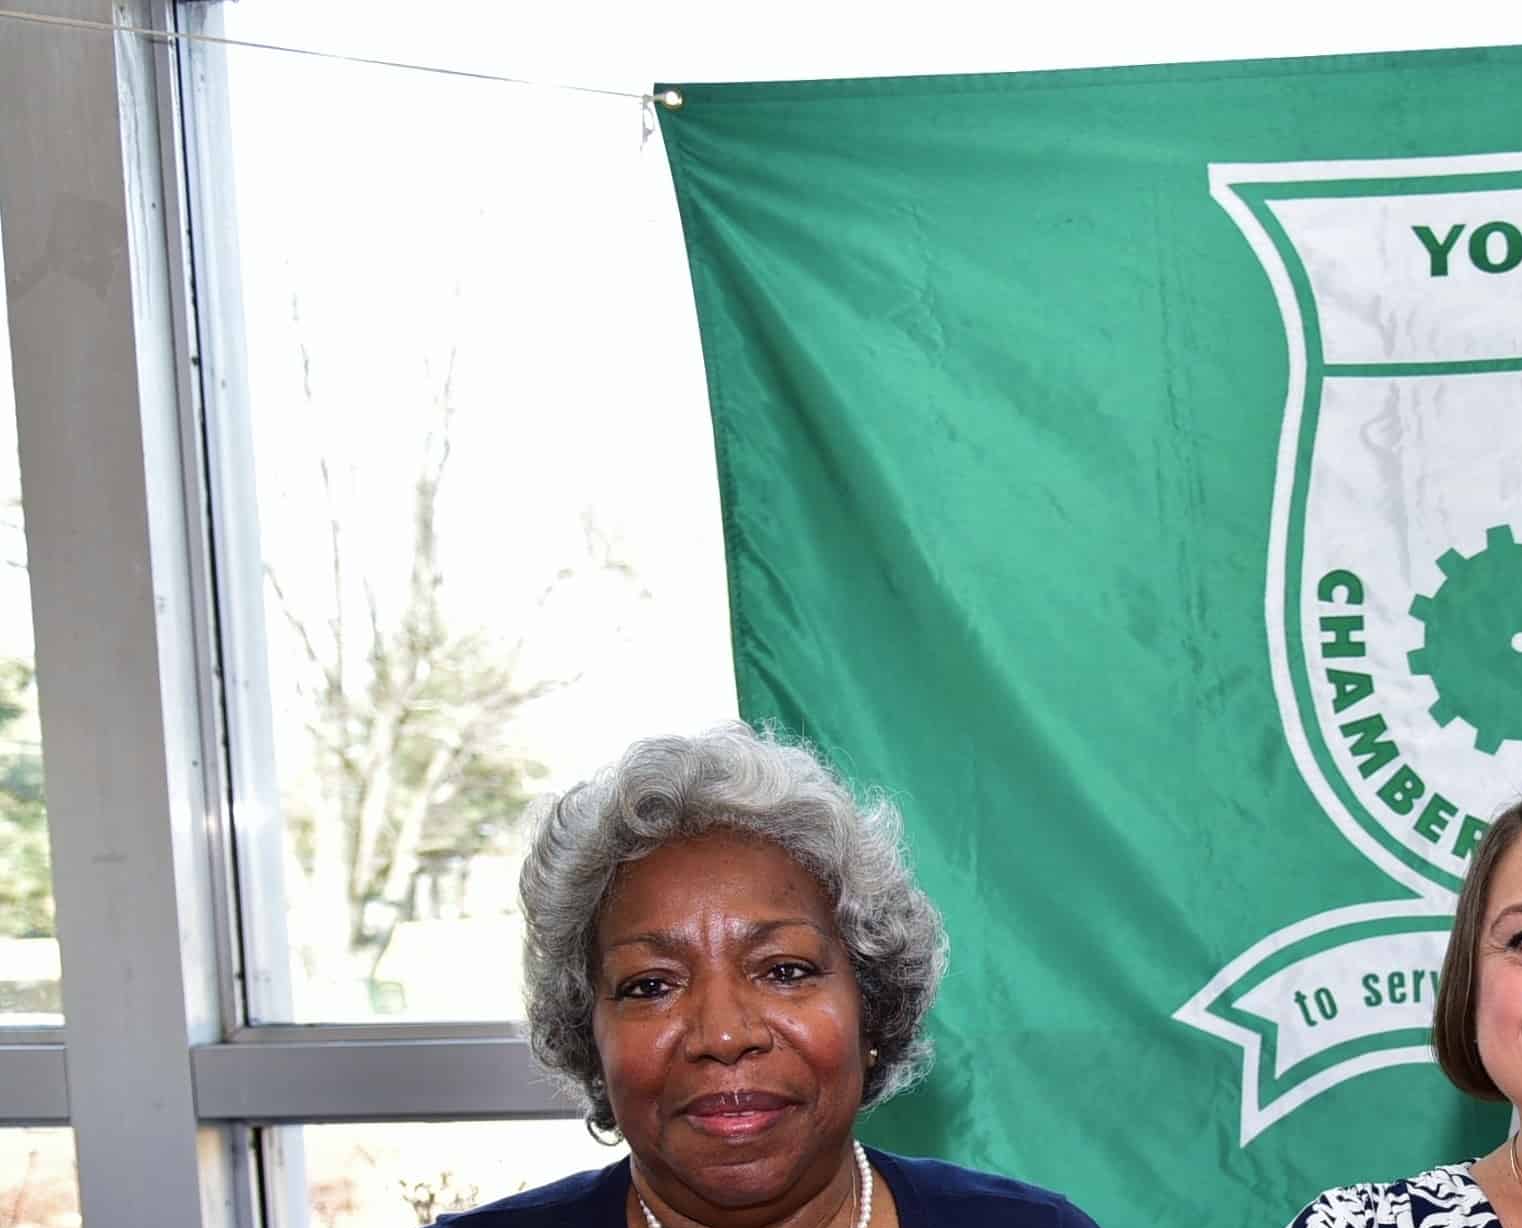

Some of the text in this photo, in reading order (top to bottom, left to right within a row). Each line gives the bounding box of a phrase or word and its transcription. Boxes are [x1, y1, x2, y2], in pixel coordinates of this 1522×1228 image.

[1317, 569, 1490, 859] CHAMBER
[1294, 986, 1339, 1027] to
[1362, 969, 1441, 1007] serv
